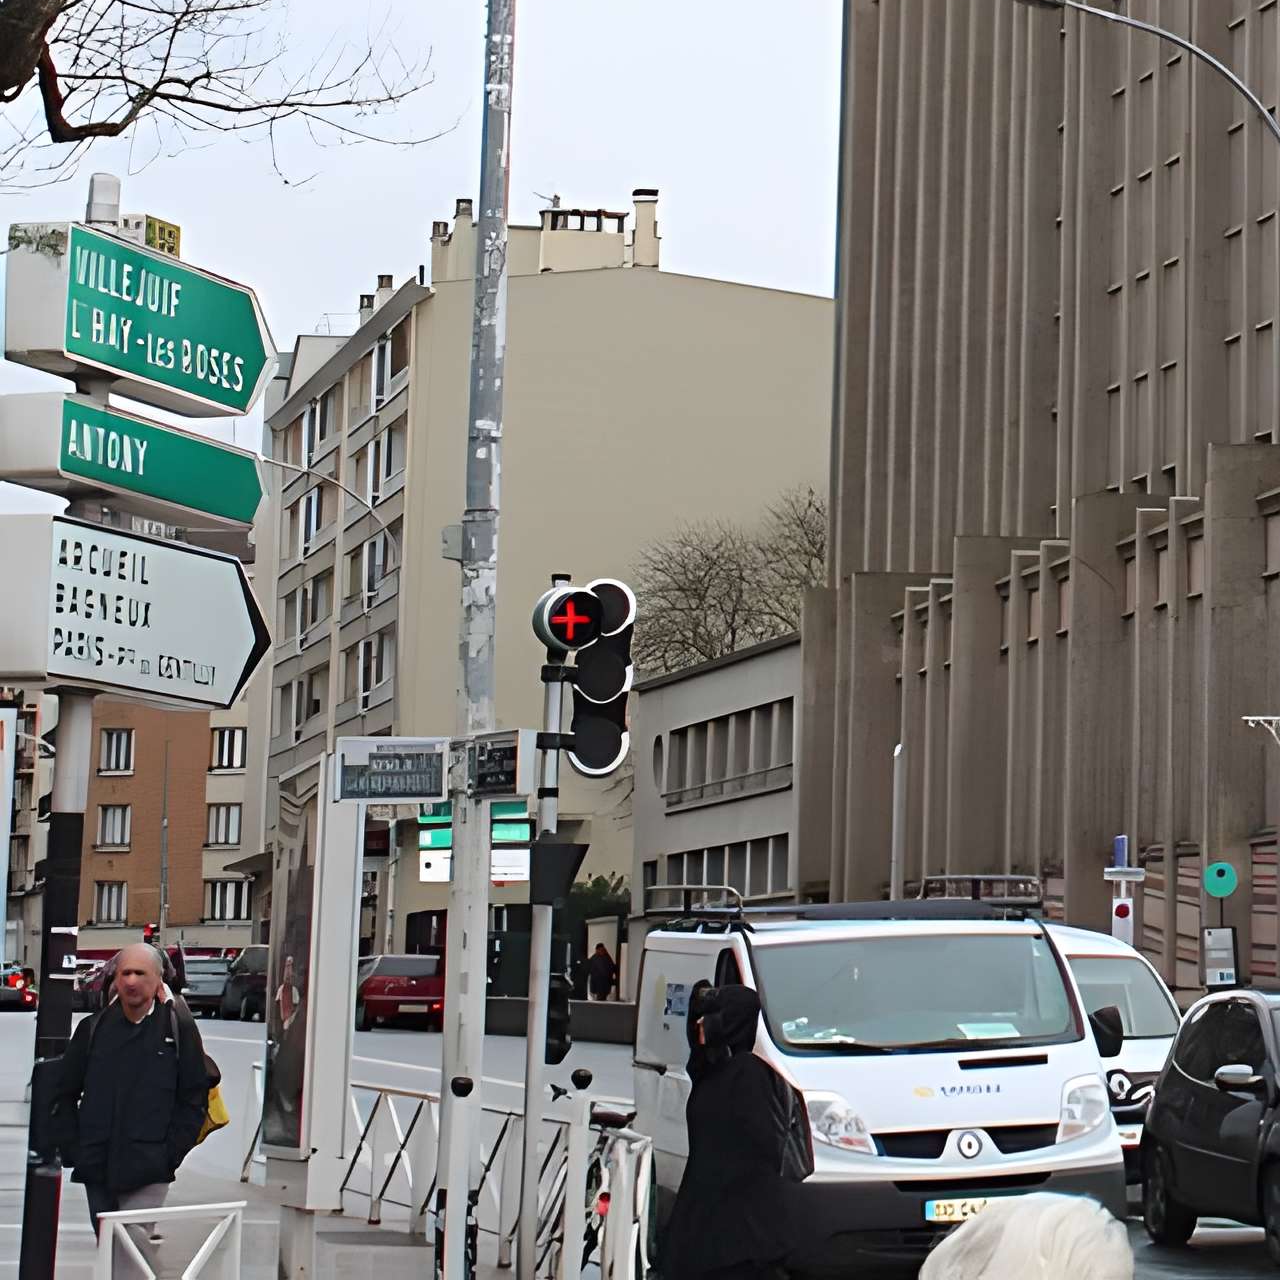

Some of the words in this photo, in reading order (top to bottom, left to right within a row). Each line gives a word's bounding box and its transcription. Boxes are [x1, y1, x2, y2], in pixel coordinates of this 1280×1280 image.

[76, 246, 182, 317] VILLEJUIF
[68, 419, 148, 476] ANTONY
[57, 539, 149, 585] ARCUEIL
[55, 582, 152, 628] BAGNEUX
